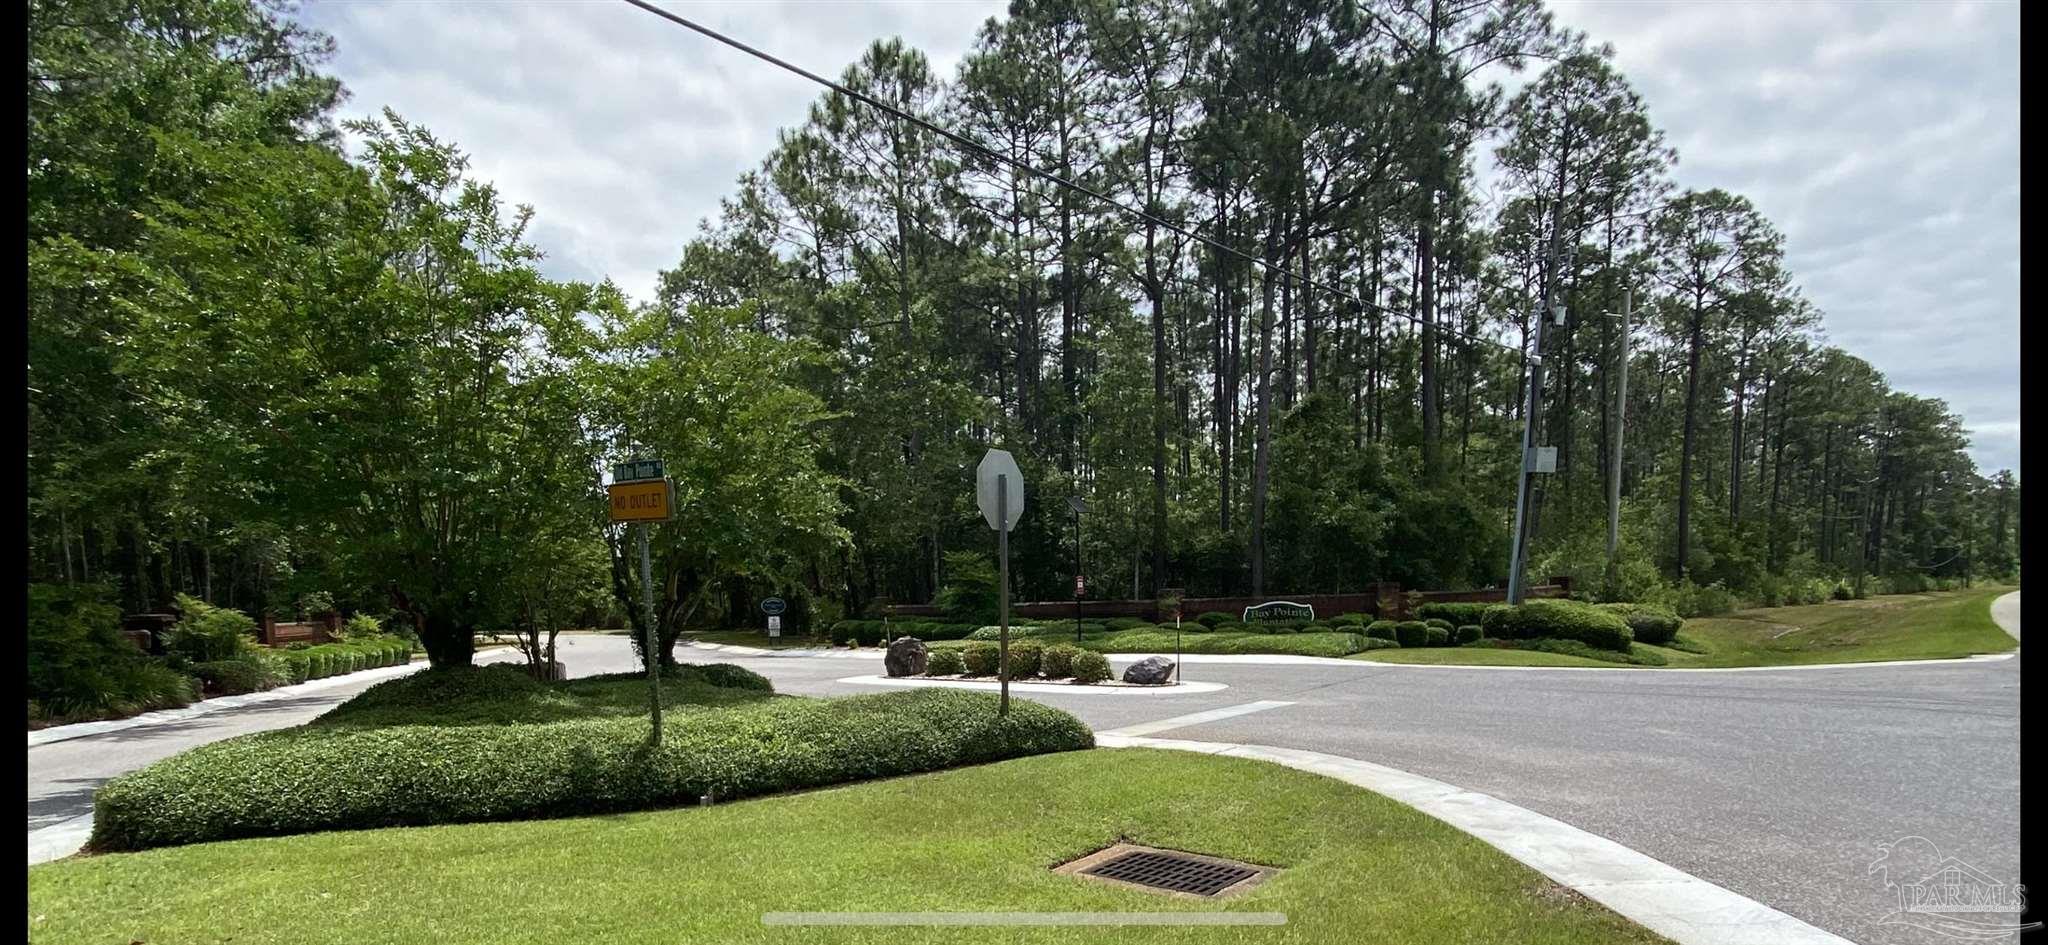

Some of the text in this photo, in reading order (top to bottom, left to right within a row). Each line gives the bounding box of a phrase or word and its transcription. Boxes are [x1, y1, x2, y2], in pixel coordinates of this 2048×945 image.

[614, 493, 661, 510] NO OUTLET
[1250, 607, 1311, 619] Bay Pointe
